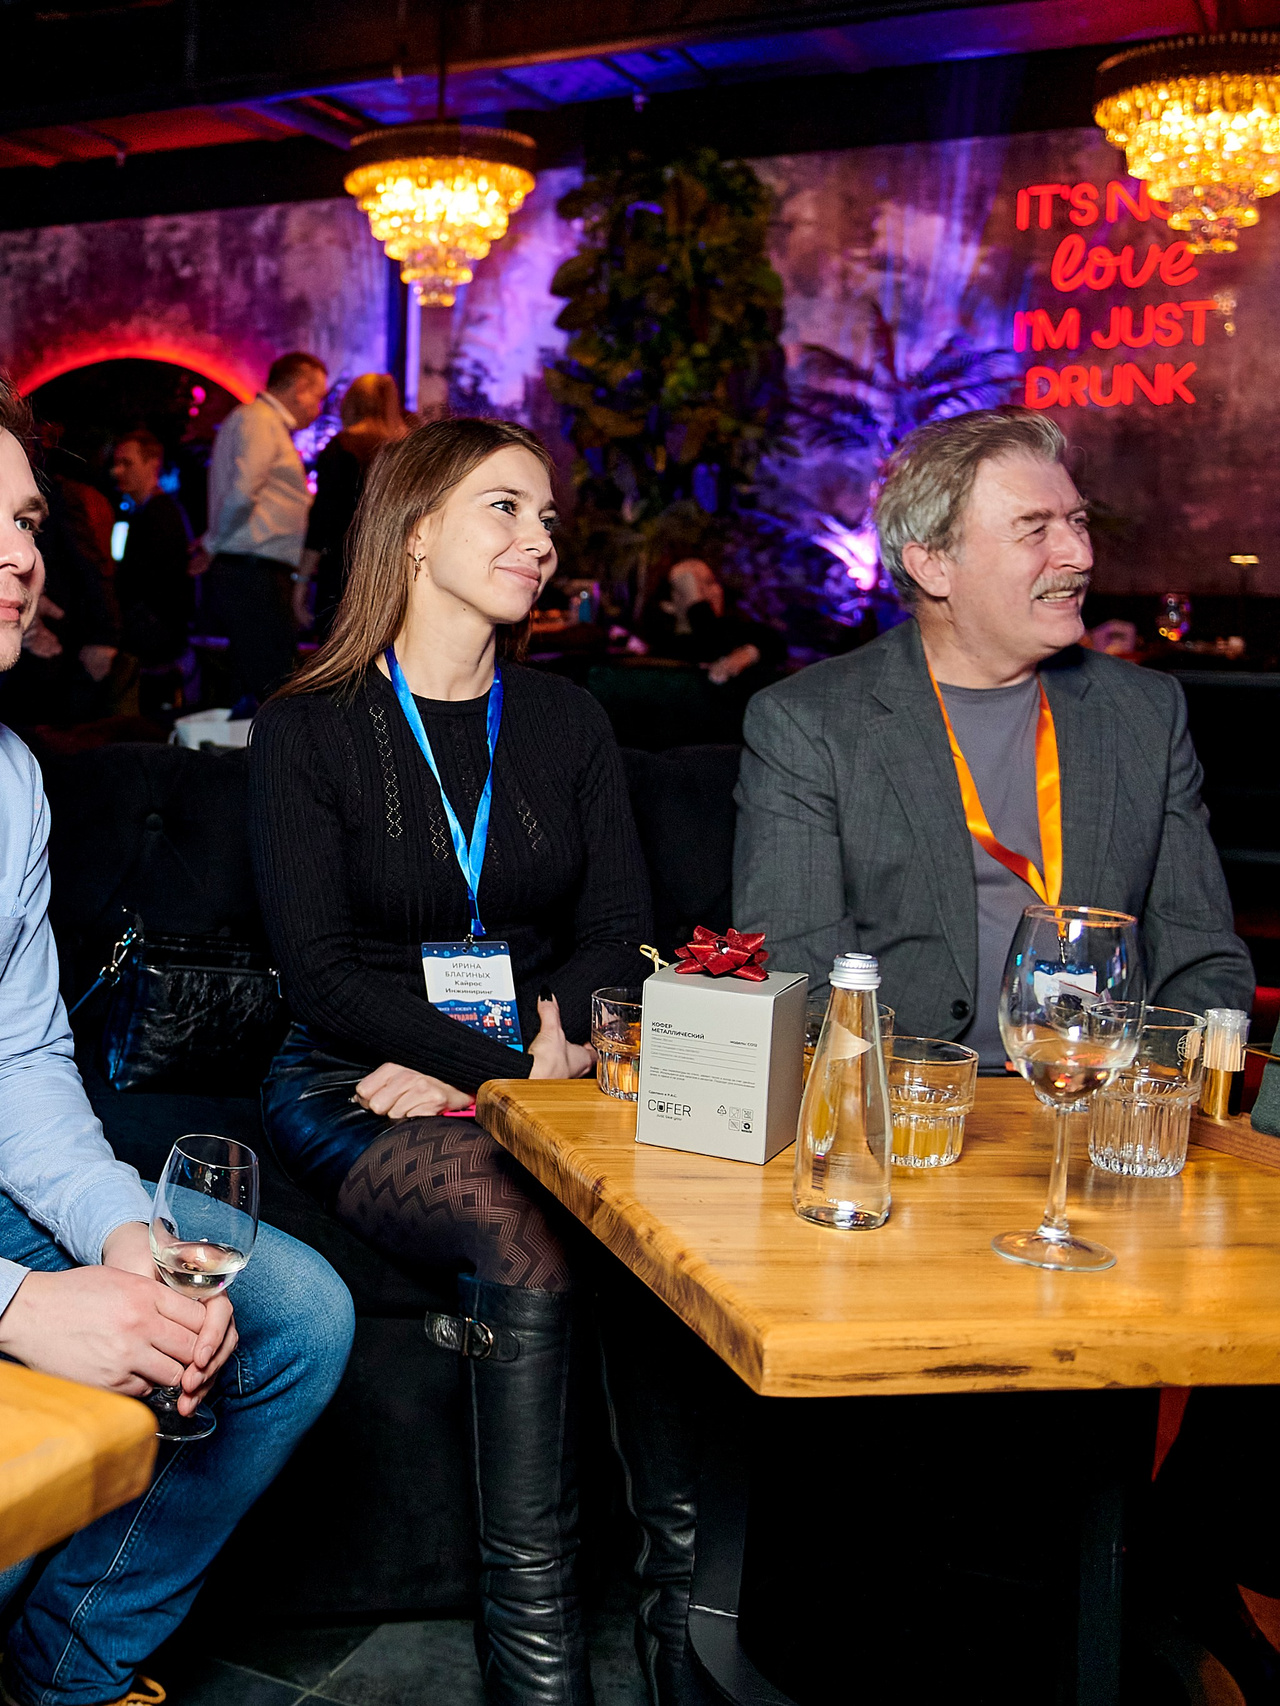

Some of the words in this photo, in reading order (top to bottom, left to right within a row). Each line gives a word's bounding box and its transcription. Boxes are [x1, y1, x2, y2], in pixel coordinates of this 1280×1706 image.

[1016, 182, 1099, 231] IT'S
[1051, 233, 1199, 292] love
[1013, 307, 1080, 353] I'M
[1091, 300, 1219, 349] JUST
[1025, 361, 1197, 409] DRUNK
[445, 971, 491, 979] БЛАГИНЫХ
[651, 1021, 673, 1029] КОФЕР
[651, 1027, 705, 1040] МЕТАЛЛИЧЕСКИЙ
[647, 1099, 692, 1117] COFER
